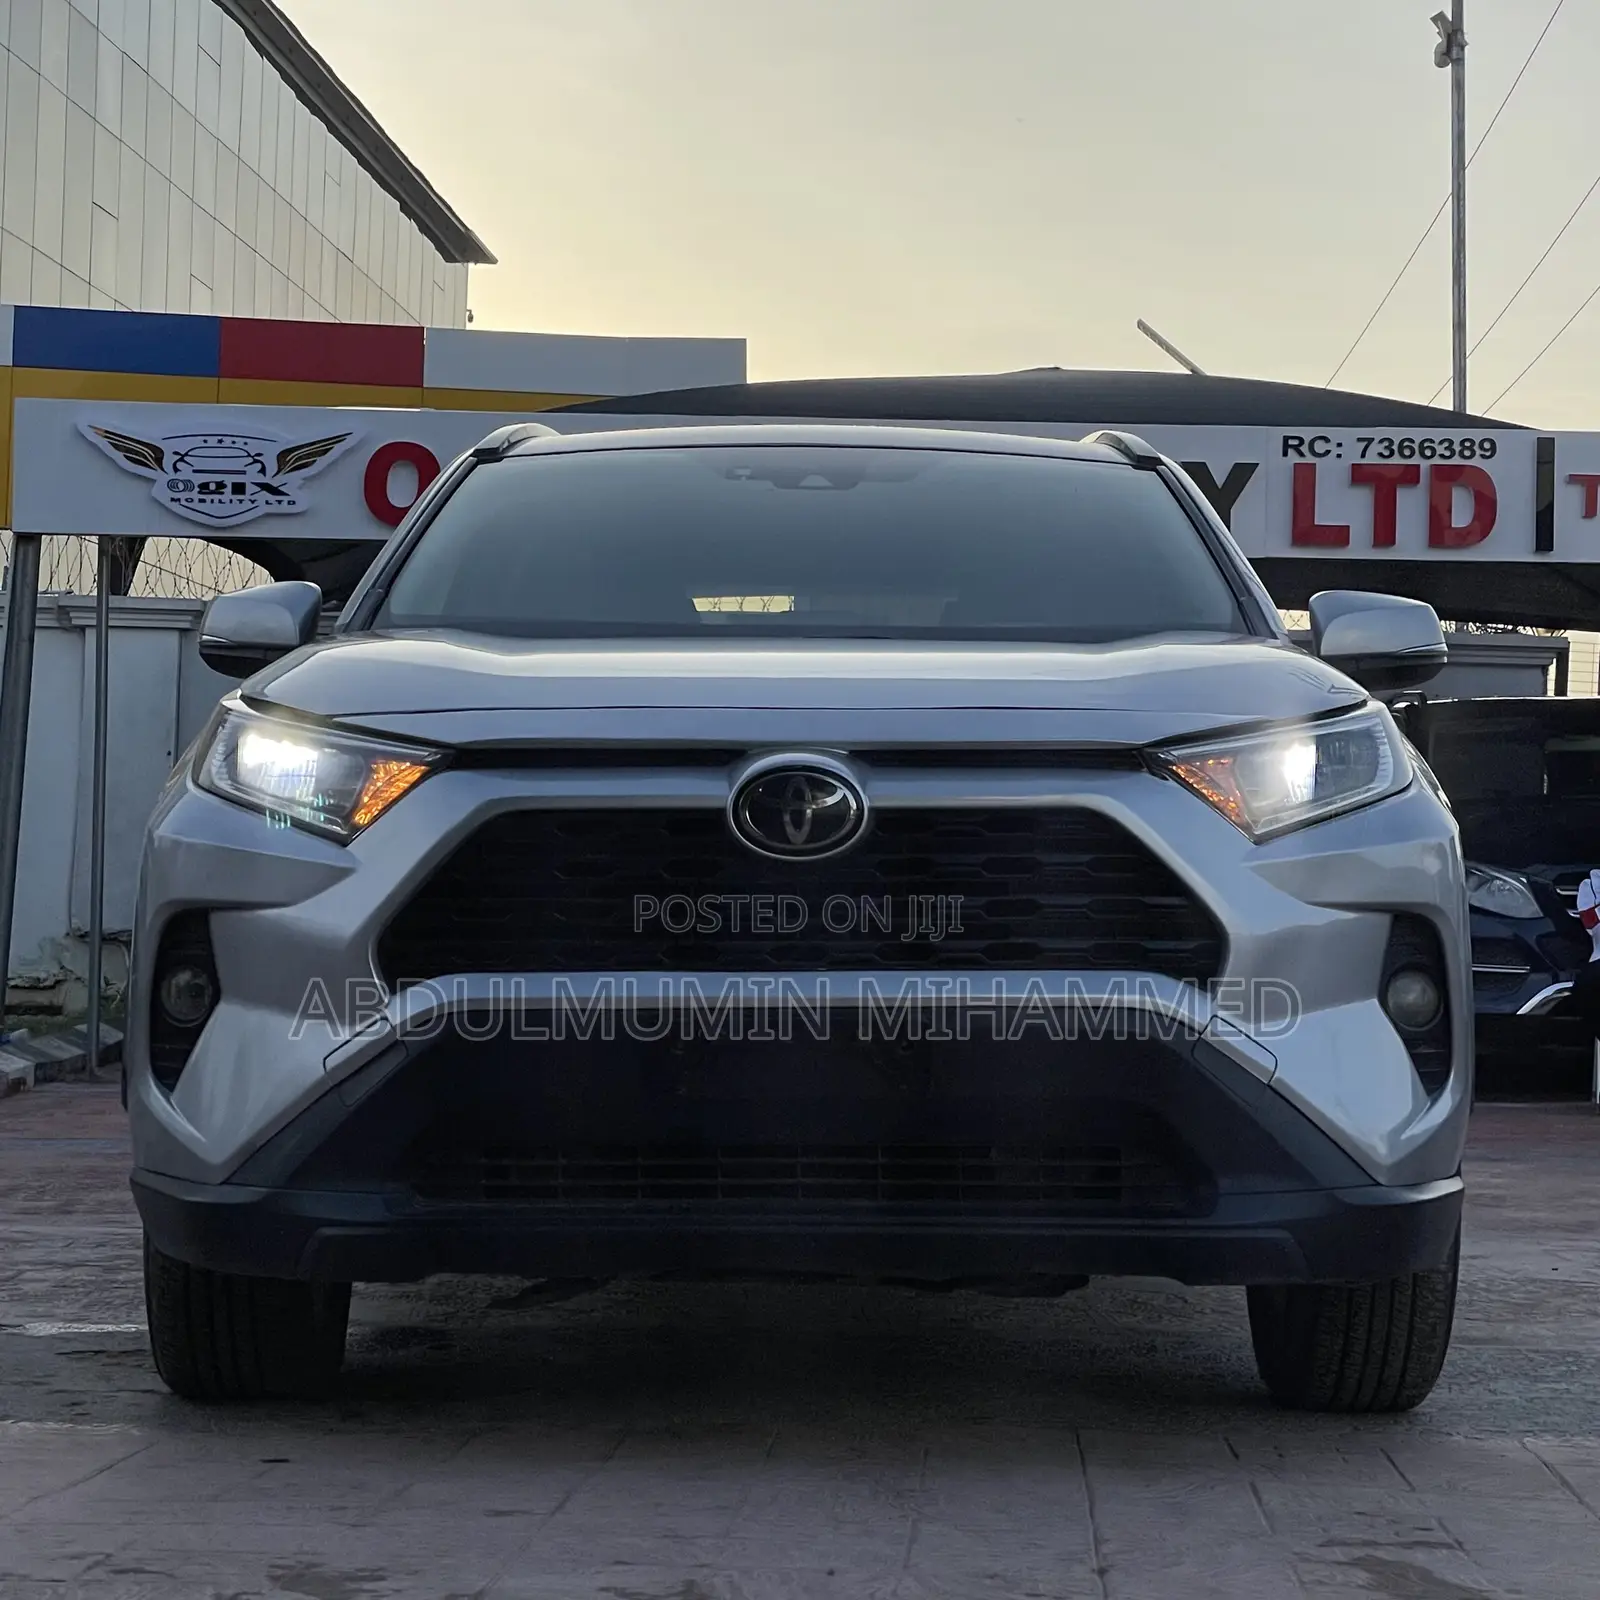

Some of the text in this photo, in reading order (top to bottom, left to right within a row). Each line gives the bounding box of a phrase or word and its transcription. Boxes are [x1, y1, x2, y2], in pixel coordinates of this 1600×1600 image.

[1282, 435, 1497, 459] RC: 7366389
[1292, 462, 1498, 548] LTD
